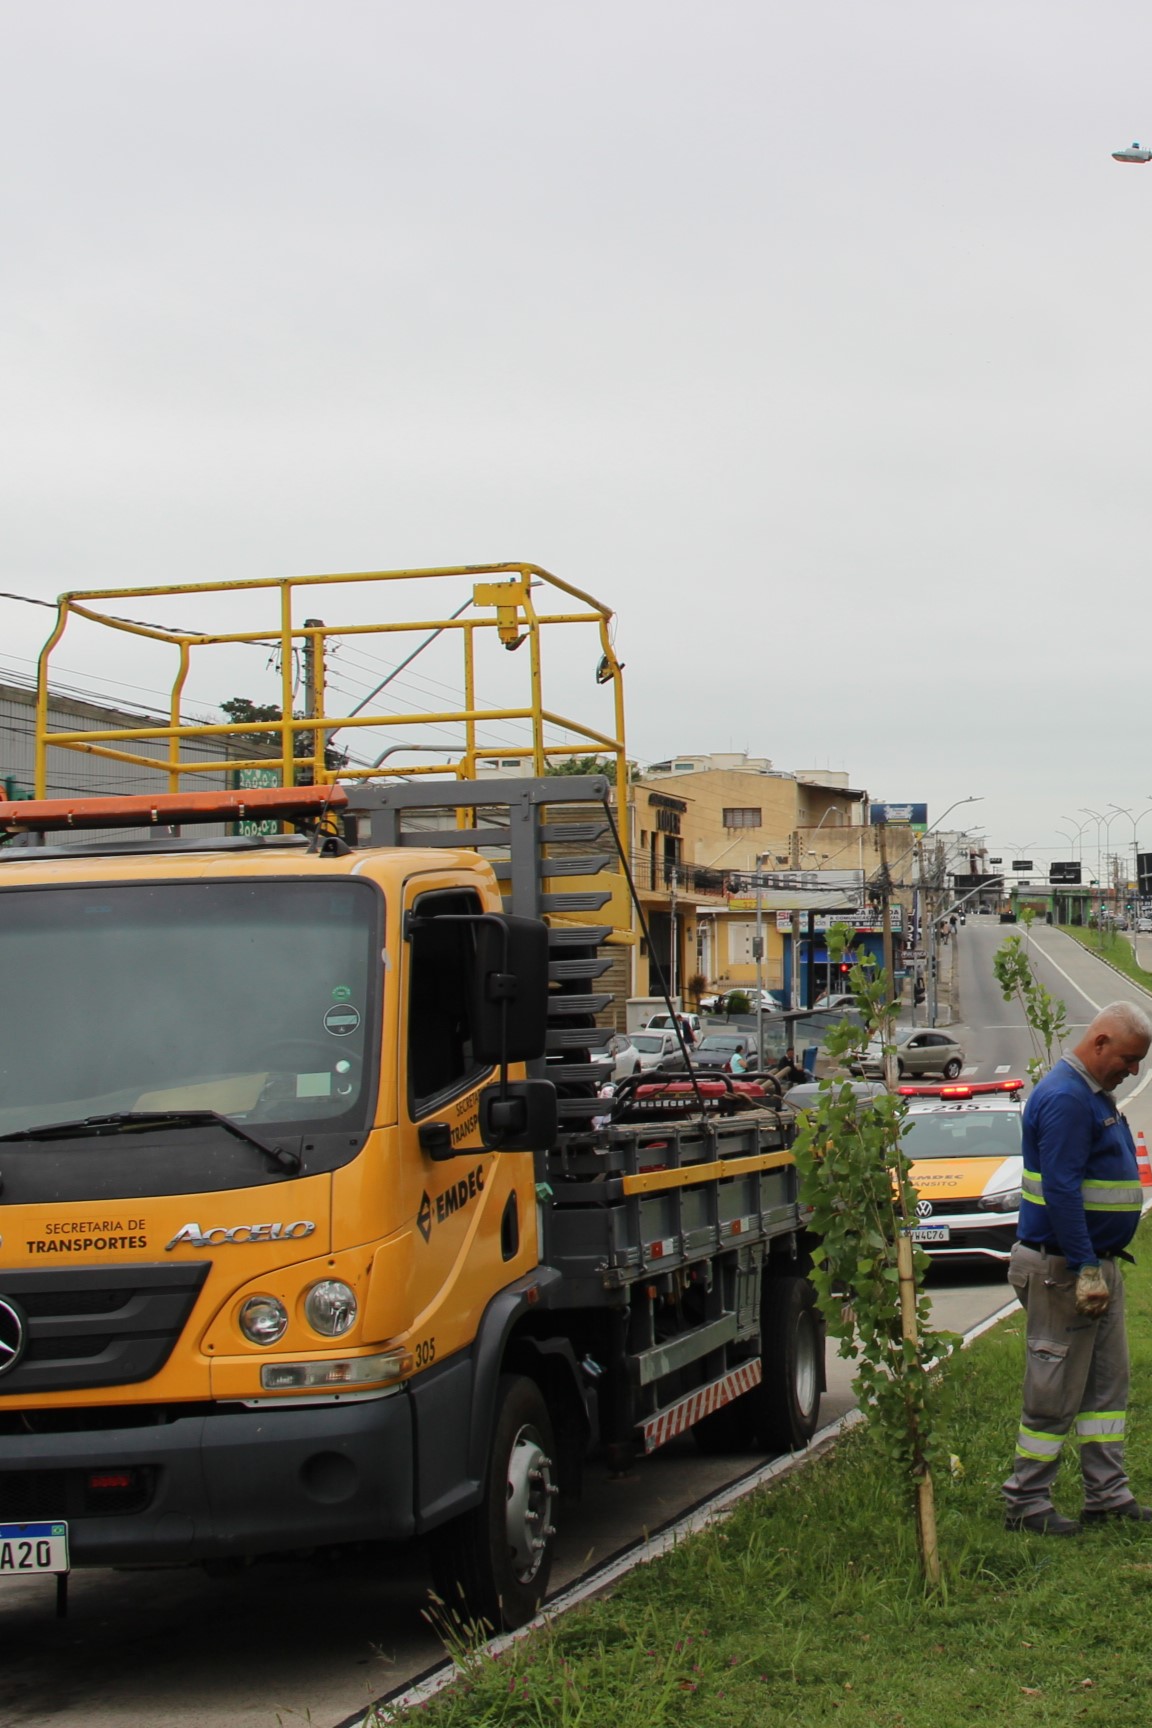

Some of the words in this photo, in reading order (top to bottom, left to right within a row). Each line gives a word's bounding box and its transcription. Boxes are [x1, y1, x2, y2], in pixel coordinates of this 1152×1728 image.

[931, 1104, 980, 1113] 245
[435, 1164, 485, 1225] EMDEC
[45, 1219, 124, 1236] SECRETARIA
[127, 1218, 146, 1231] DE
[26, 1235, 148, 1255] TRANSPORTES
[415, 1336, 436, 1369] 305
[0, 1540, 52, 1570] A20
